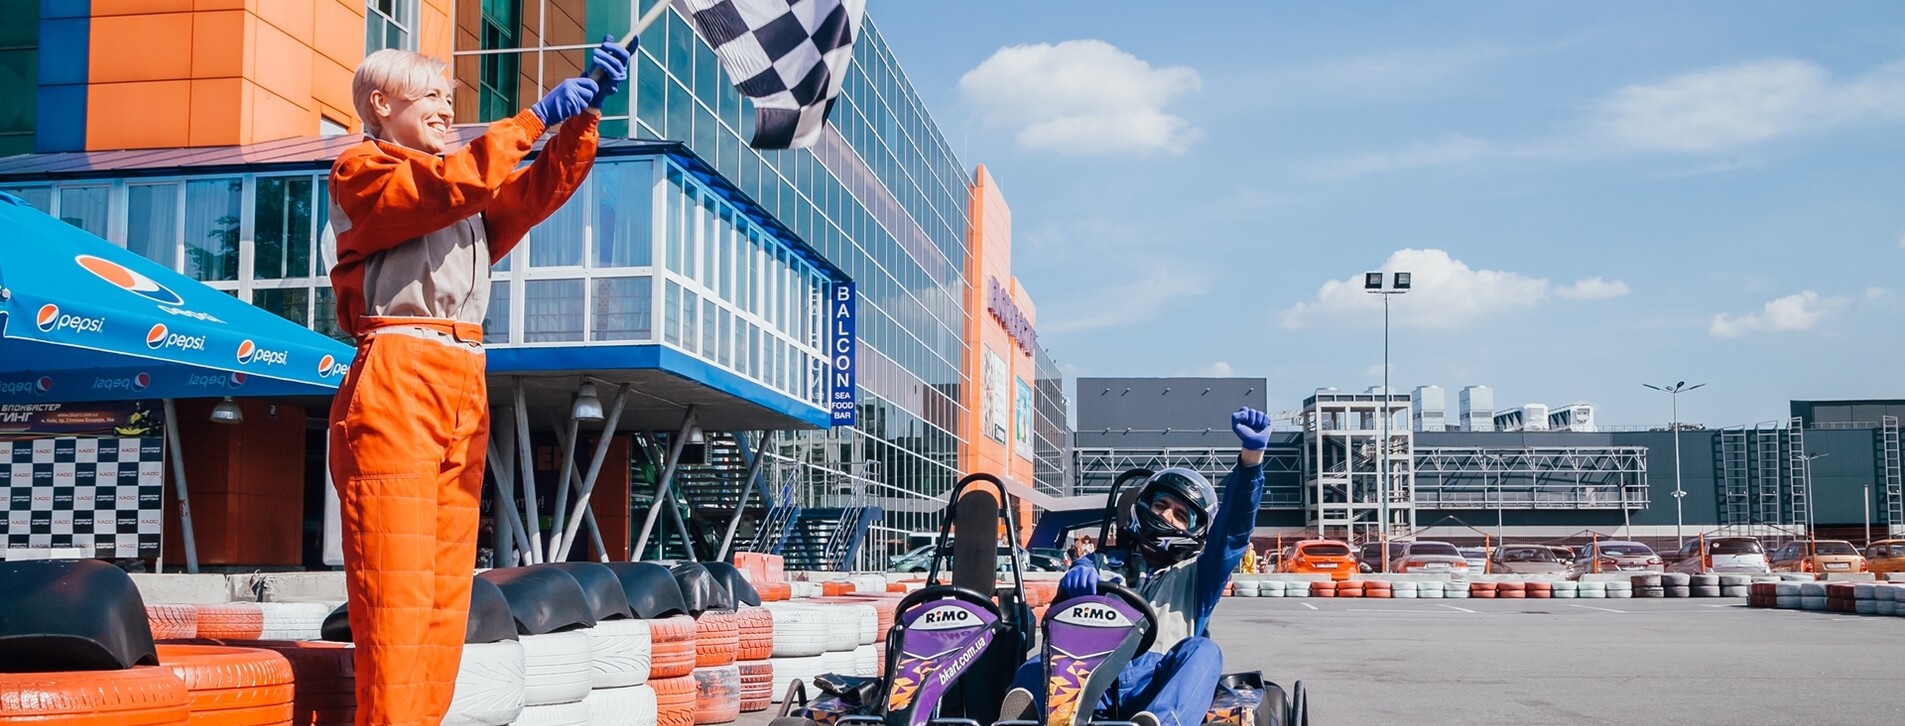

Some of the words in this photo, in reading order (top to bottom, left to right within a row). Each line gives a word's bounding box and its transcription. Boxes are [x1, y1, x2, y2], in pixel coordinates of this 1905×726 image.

[57, 314, 105, 333] pepsi
[165, 333, 206, 351] pepsi
[836, 286, 850, 388] BALCON
[253, 348, 288, 365] pepsi
[939, 637, 986, 685] bkart.com.ua
